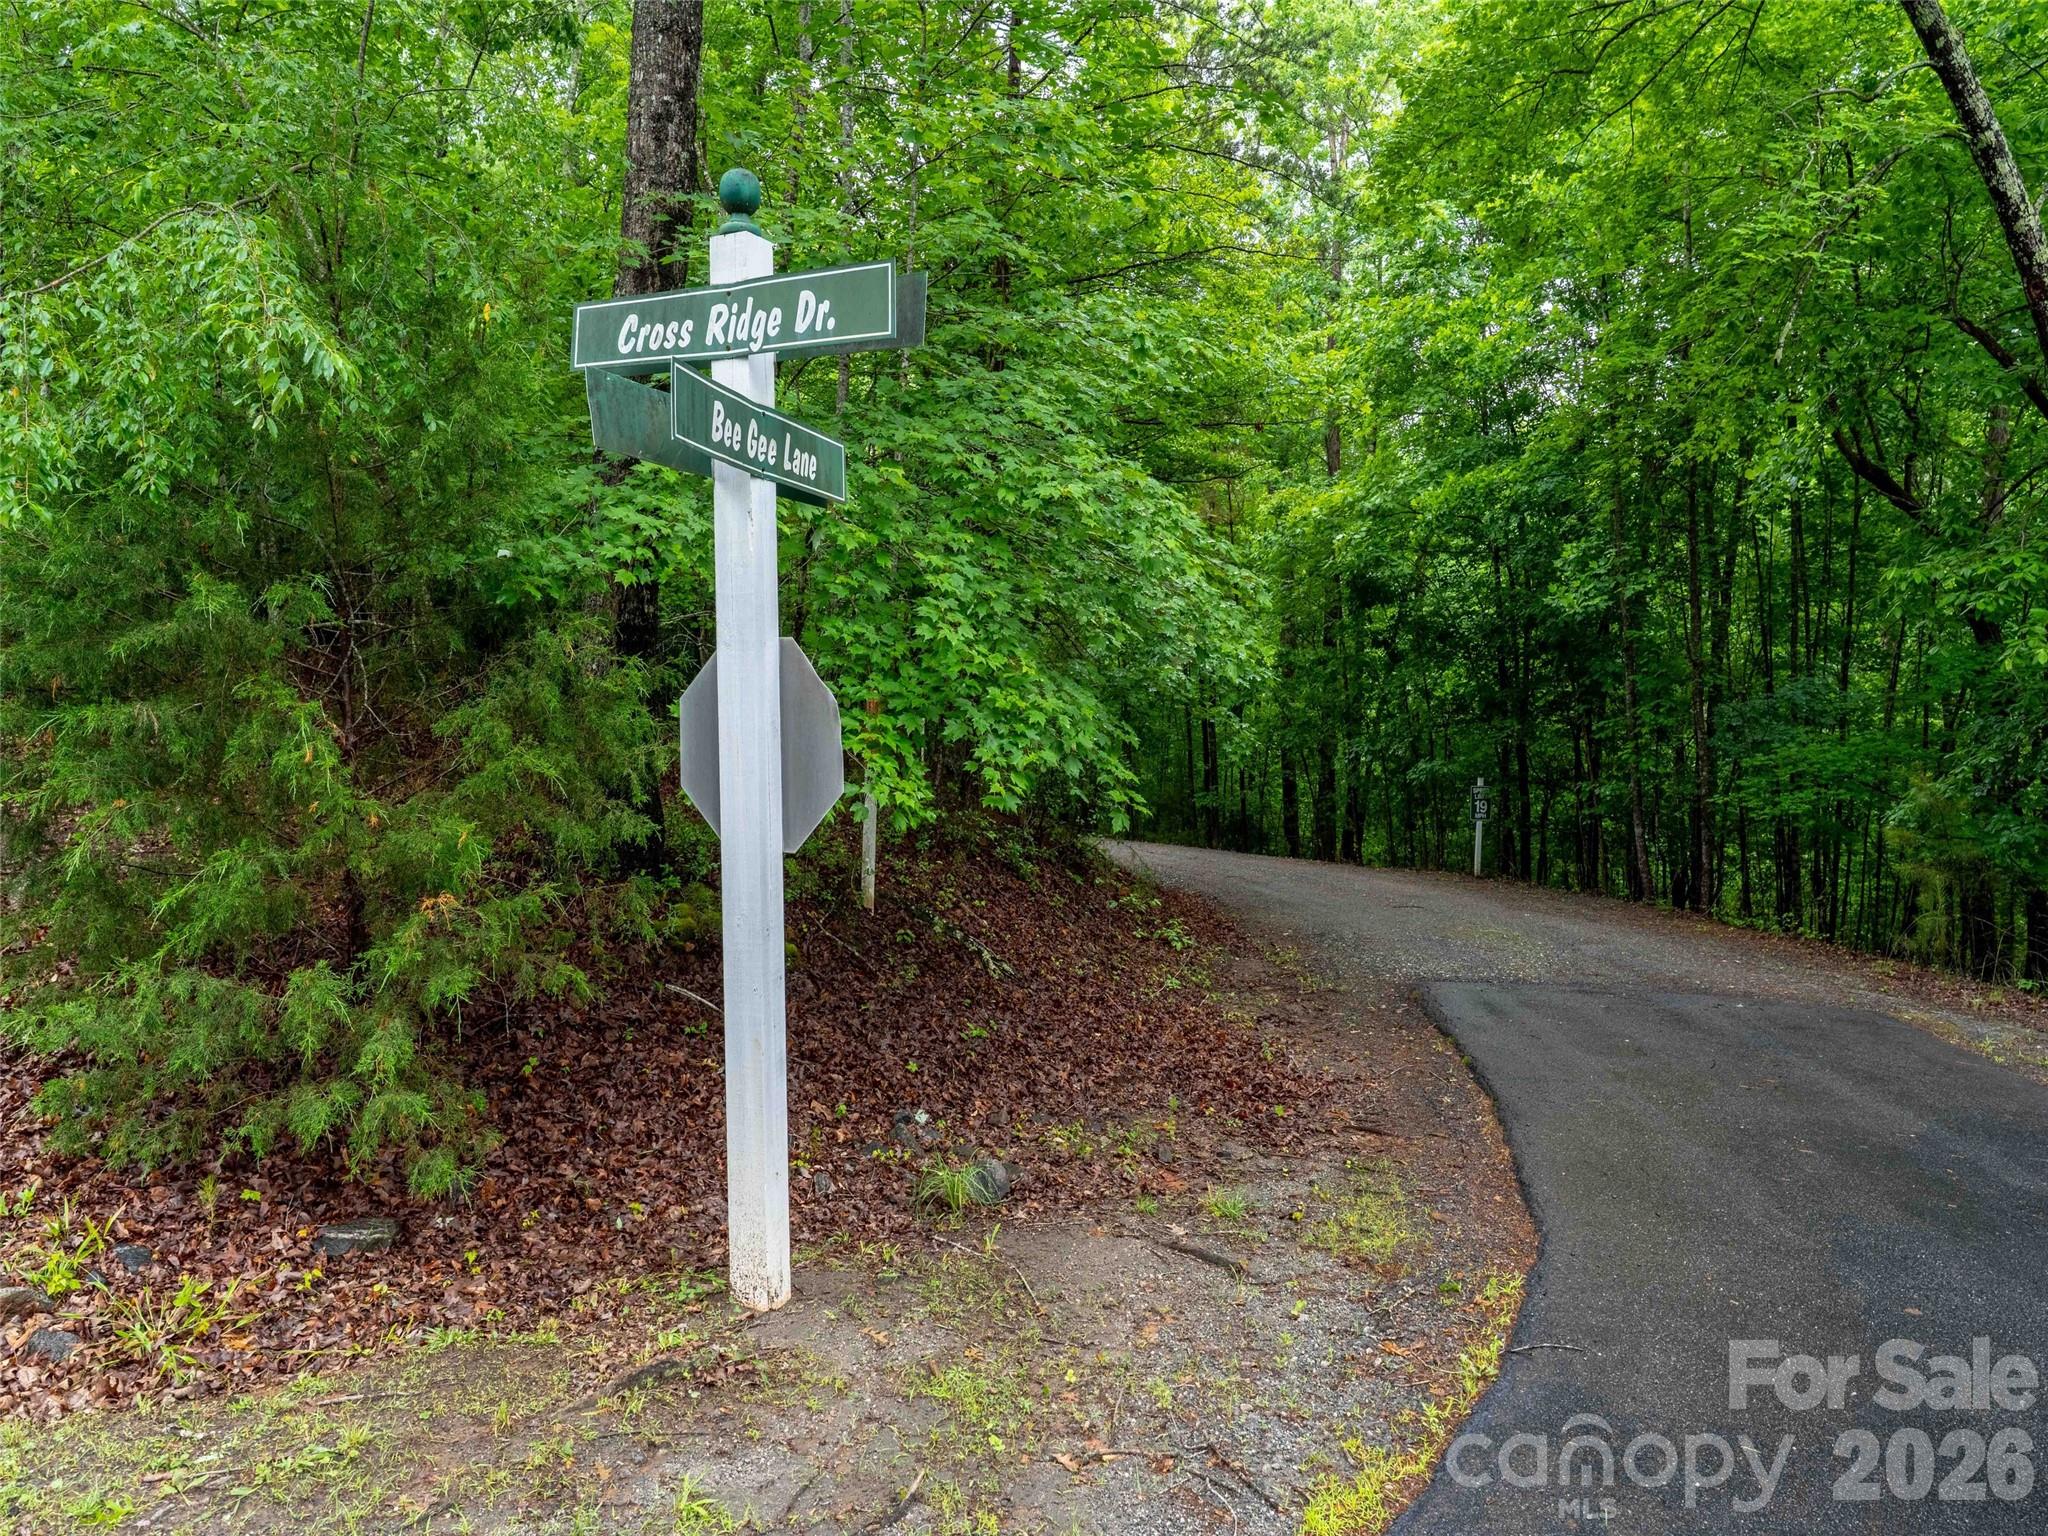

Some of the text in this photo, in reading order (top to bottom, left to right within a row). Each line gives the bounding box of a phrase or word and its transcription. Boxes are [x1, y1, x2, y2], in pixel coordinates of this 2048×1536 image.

[617, 290, 836, 354] Cross Ridge Dr.
[711, 400, 817, 481] Bee Gee Lane
[1474, 800, 1487, 813] 19
